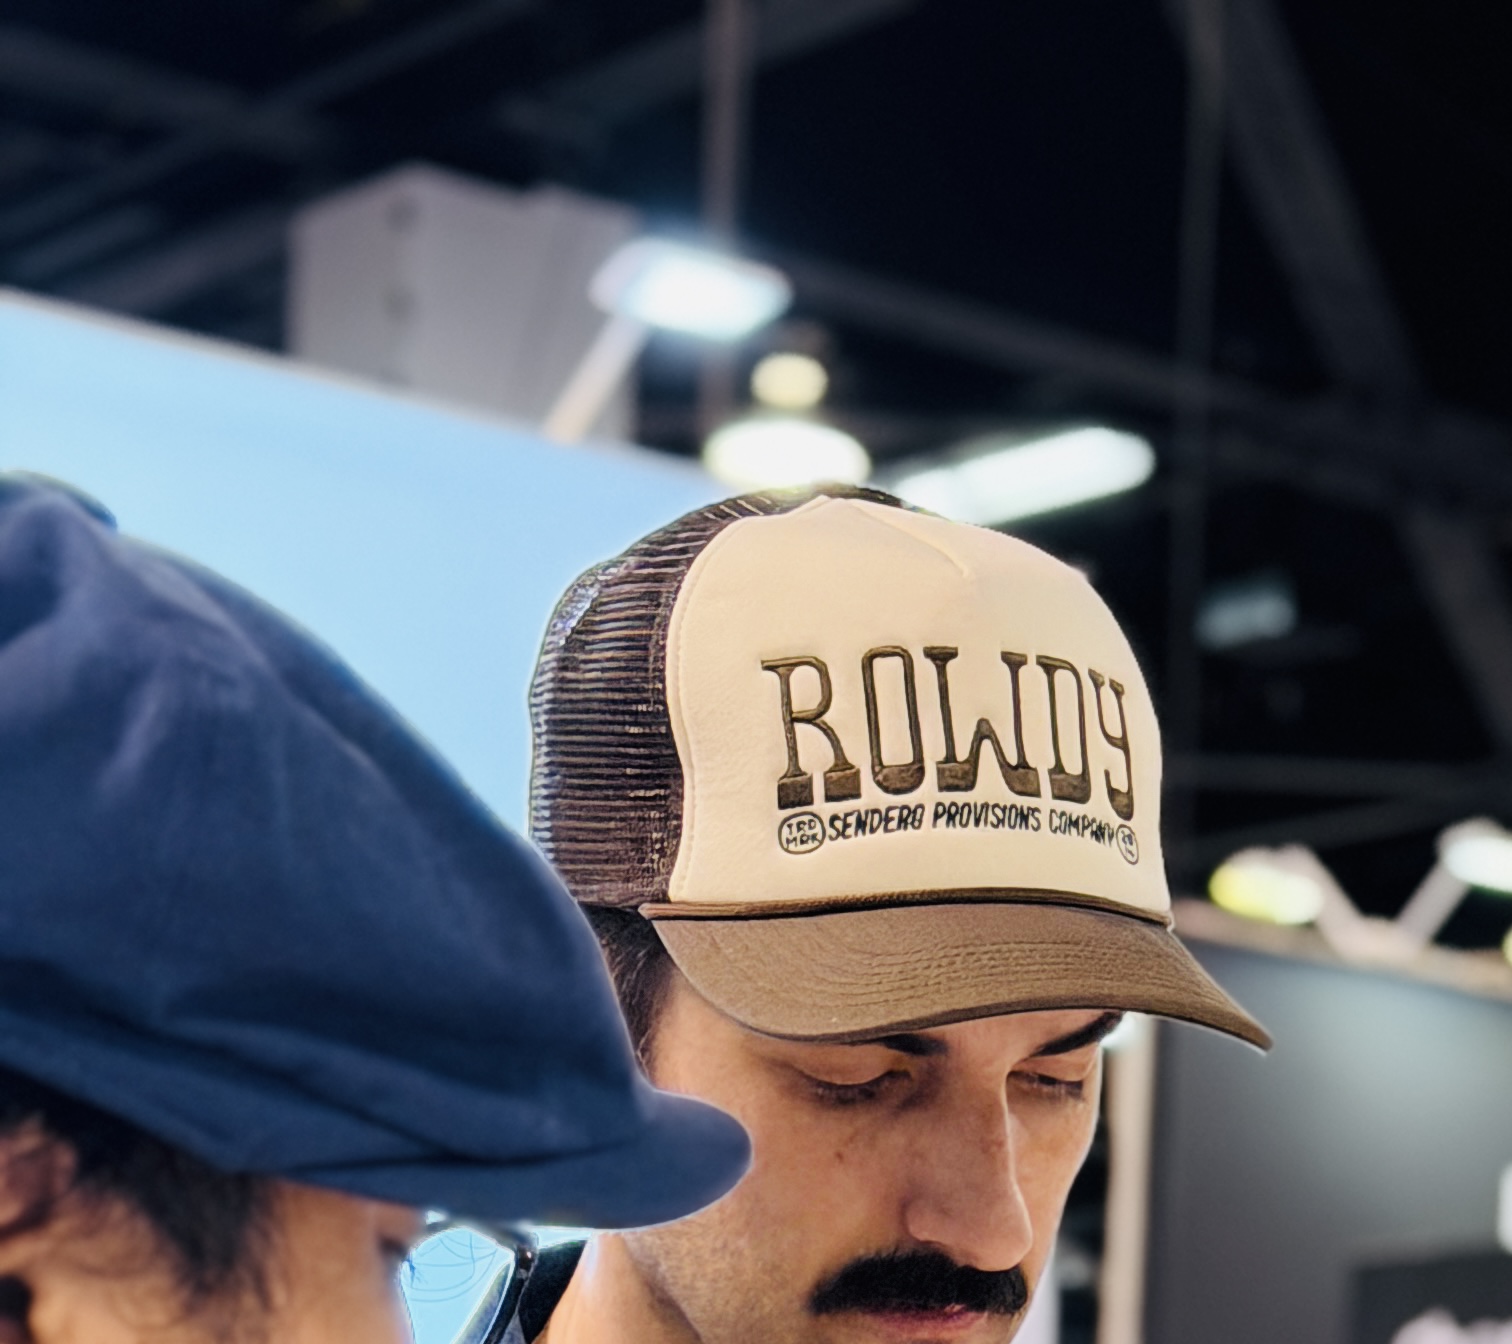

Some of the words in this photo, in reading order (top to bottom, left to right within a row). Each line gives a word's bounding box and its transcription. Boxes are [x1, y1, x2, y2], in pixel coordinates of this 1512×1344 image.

[761, 645, 1135, 821] ROWDY
[828, 802, 926, 842] SENDERO
[932, 800, 1042, 833] PROVISIONS
[1049, 808, 1115, 848] COMPANY
